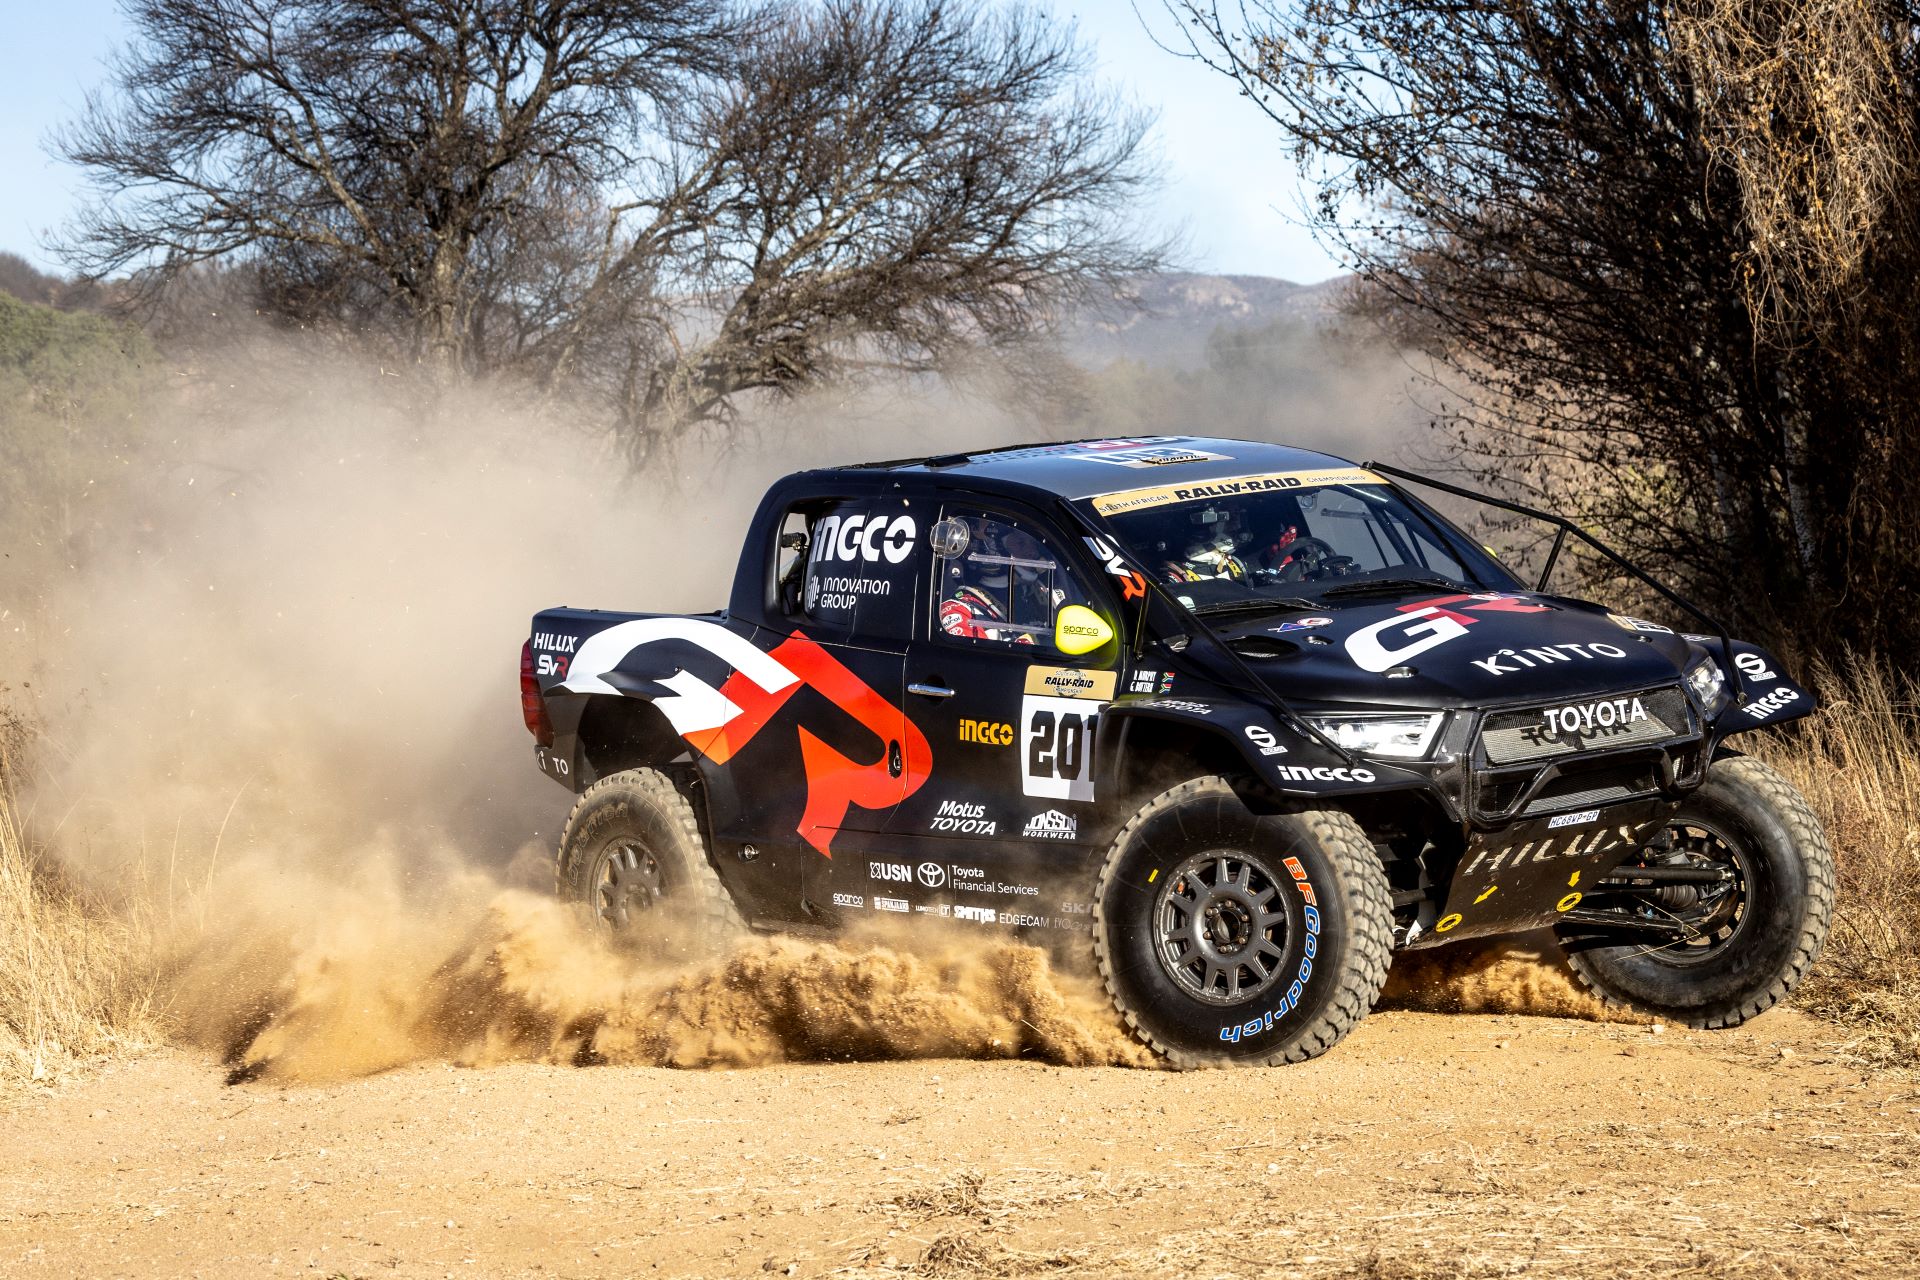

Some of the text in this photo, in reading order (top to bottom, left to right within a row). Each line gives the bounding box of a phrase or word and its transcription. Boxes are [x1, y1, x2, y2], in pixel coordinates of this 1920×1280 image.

[1130, 492, 1169, 508] AFRICAN
[1174, 476, 1302, 501] RALLY-RAID
[820, 593, 857, 610] GROUP
[1063, 625, 1099, 636] sparco
[533, 632, 579, 654] HILUX
[1544, 697, 1648, 734] TOYOTA
[1028, 710, 1099, 783] 201
[936, 800, 986, 819] Motus
[929, 817, 997, 836] TOYOTA
[1022, 829, 1076, 840] WORKWEAR
[881, 862, 912, 883] USN
[951, 864, 985, 879] Toyota
[953, 878, 1040, 896] Financial Services
[833, 892, 864, 907] sparco
[999, 912, 1050, 929] EDGECAM
